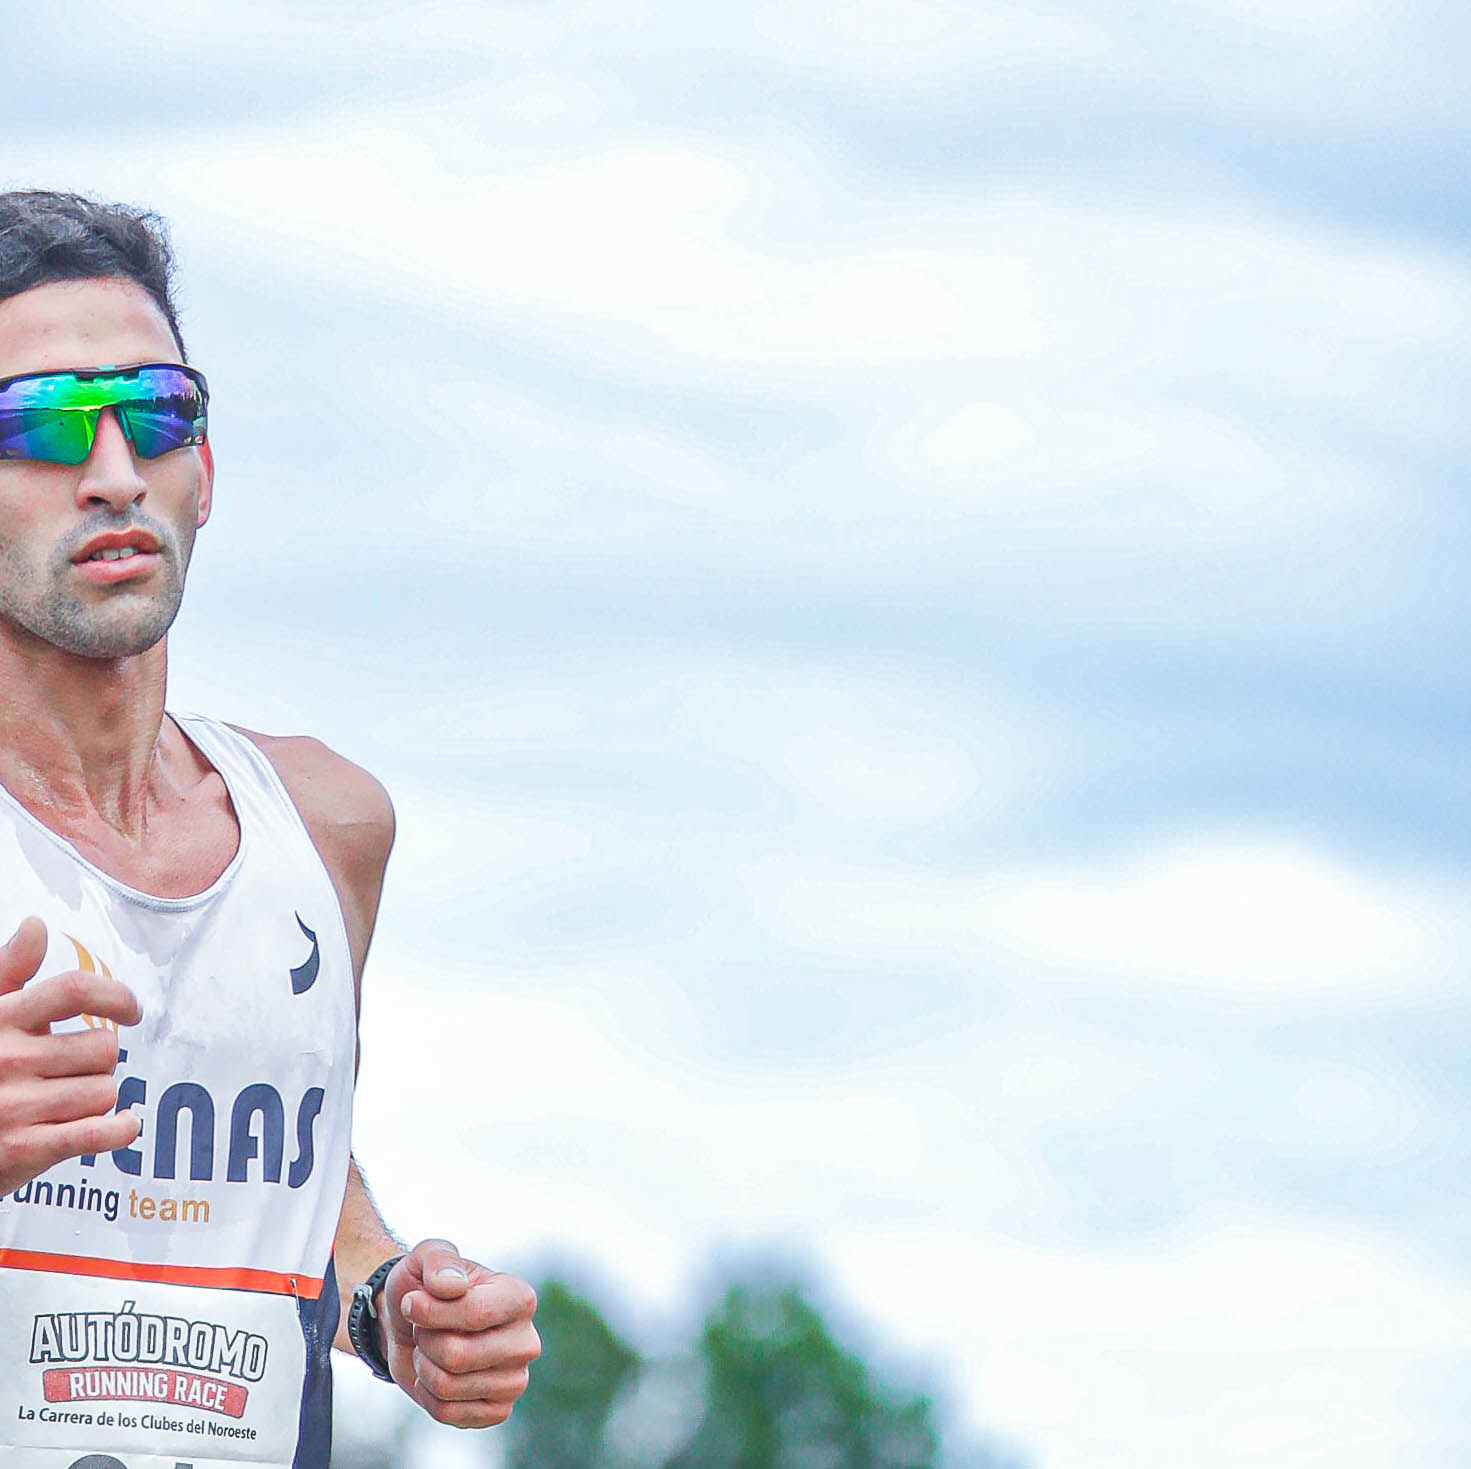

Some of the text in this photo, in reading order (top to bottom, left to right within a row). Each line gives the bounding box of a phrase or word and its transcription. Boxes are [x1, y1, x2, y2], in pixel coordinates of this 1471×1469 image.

[80, 1047, 326, 1189] ENAS
[129, 1188, 210, 1223] team
[29, 1300, 268, 1382] AUTÓDROMO
[69, 1368, 228, 1411] RUNNING RACE
[18, 1405, 257, 1440] La Carrera de los Clubes del Noroeste
